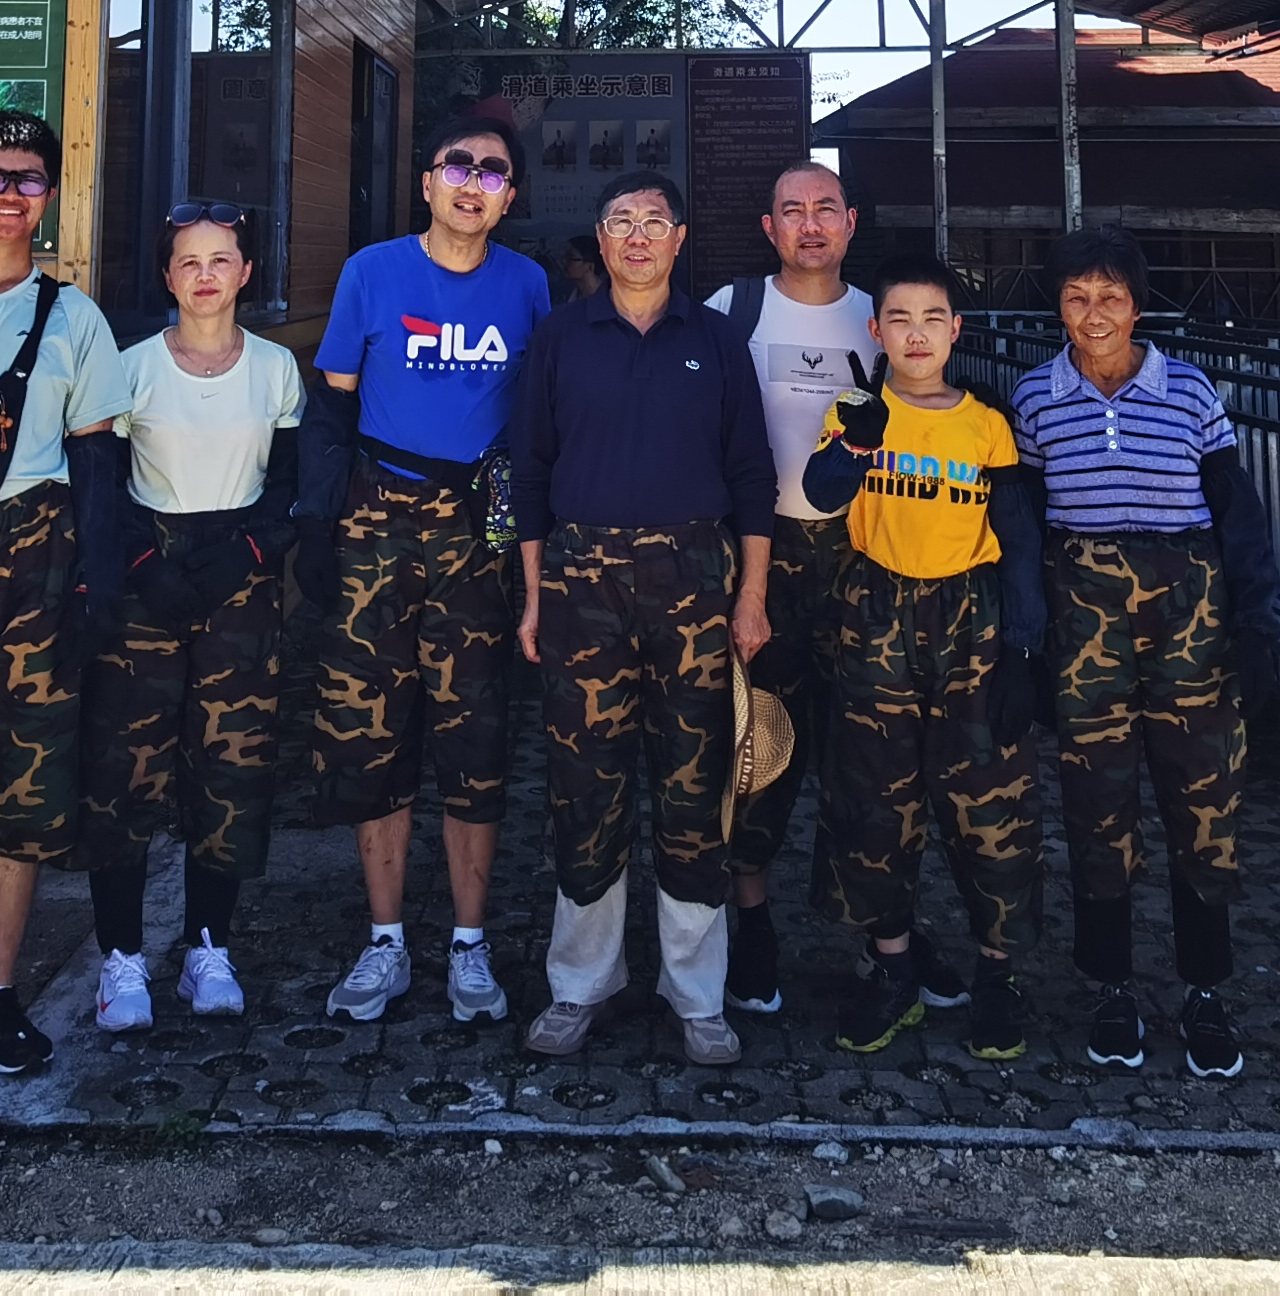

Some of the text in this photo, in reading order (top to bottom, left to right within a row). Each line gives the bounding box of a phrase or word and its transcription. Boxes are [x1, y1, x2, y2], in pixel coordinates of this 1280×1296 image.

[501, 73, 674, 99] 滑道乘坐示意图
[401, 314, 508, 361] FILA
